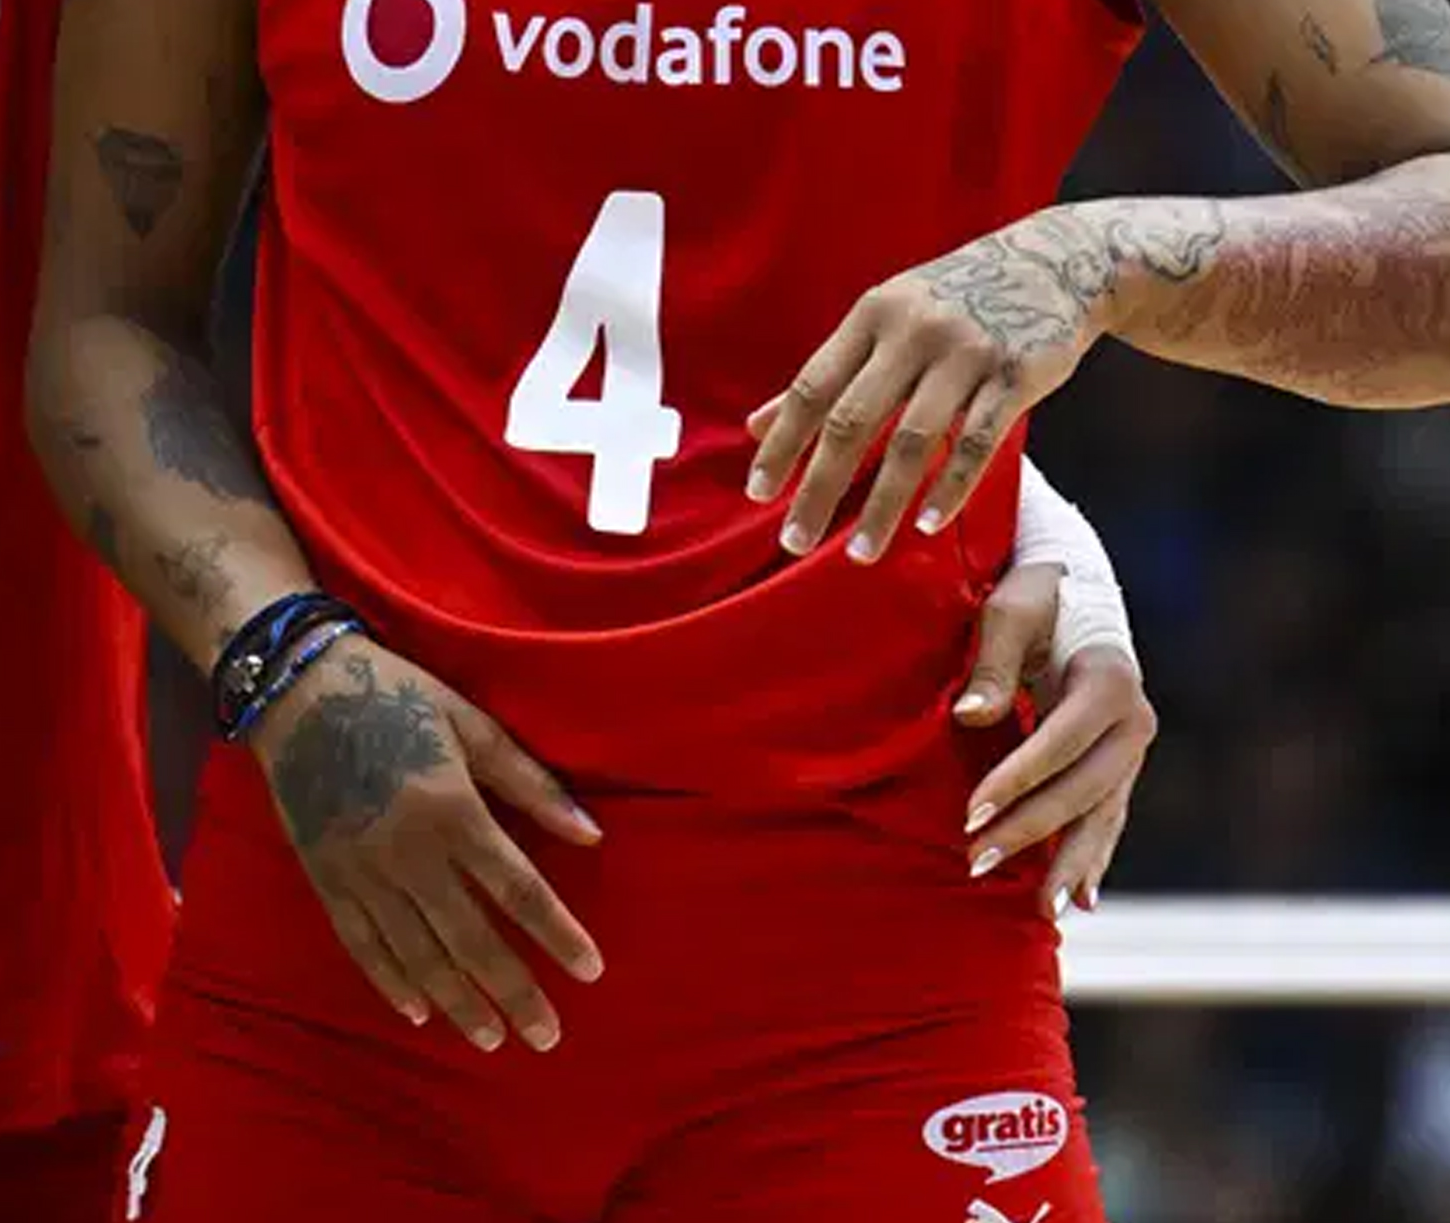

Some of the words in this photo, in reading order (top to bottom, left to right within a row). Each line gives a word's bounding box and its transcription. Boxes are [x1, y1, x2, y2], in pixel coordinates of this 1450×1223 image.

[492, 3, 906, 93] vodafone
[504, 189, 682, 536] 4
[941, 1099, 1059, 1152] gratis
